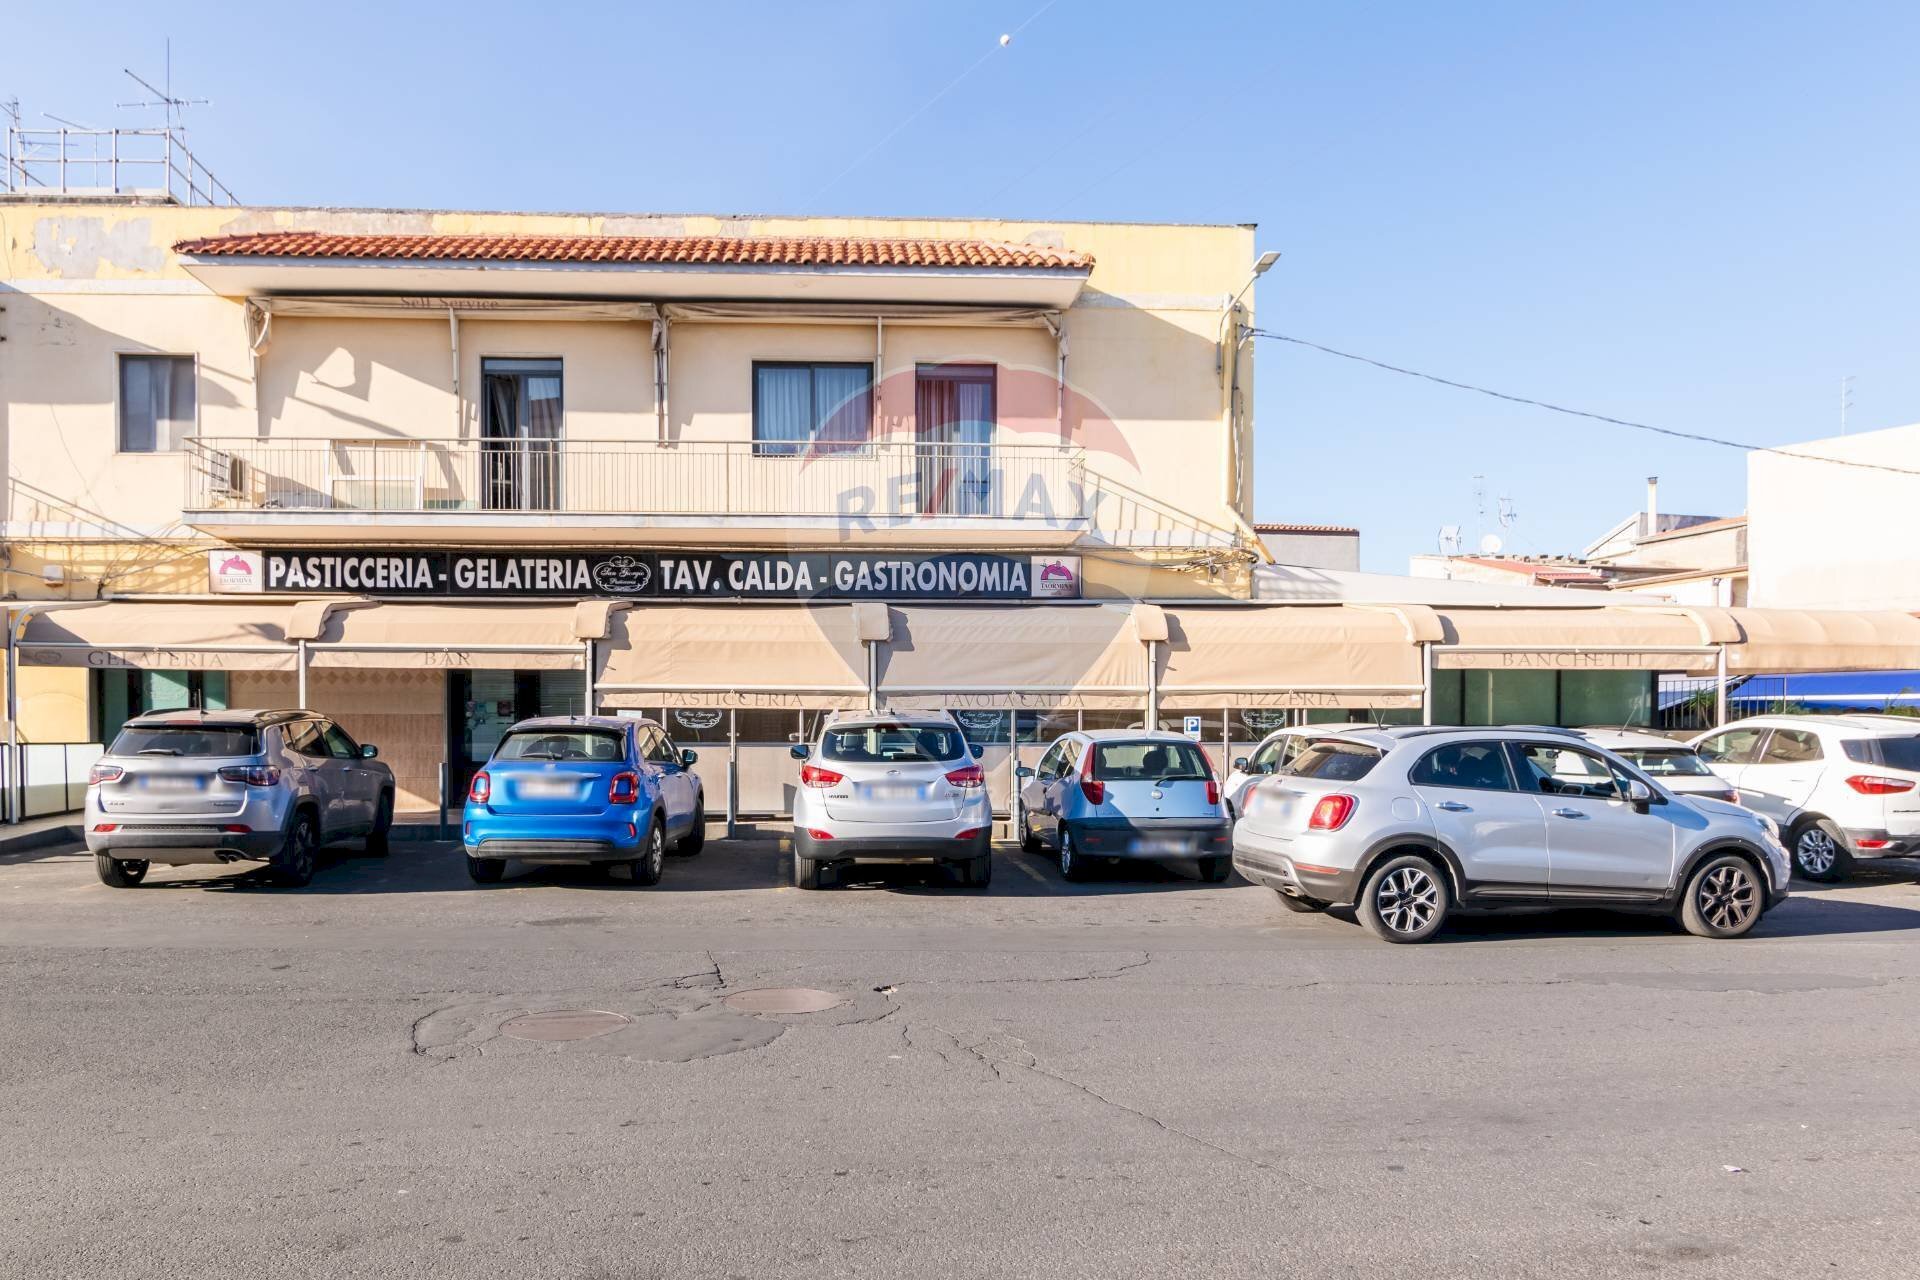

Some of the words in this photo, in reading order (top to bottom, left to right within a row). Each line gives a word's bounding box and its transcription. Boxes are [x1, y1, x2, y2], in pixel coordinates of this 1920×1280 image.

[440, 298, 498, 310] Service
[269, 556, 434, 588] PASTICCERIA
[454, 558, 592, 589] GELATERIA
[660, 560, 720, 590] TAV.
[728, 560, 813, 591] CALDA
[834, 560, 1028, 592] GASTRONOMIA
[87, 651, 225, 667] GELATERIA
[424, 652, 472, 666] BAR
[1502, 653, 1644, 667] BANCHETTI
[661, 692, 804, 707] PASTICCERIA
[942, 694, 1014, 707] TAVOLA
[1020, 694, 1085, 708] CALDA
[1234, 692, 1342, 707] PIZZERIA
[1187, 719, 1198, 731] P
